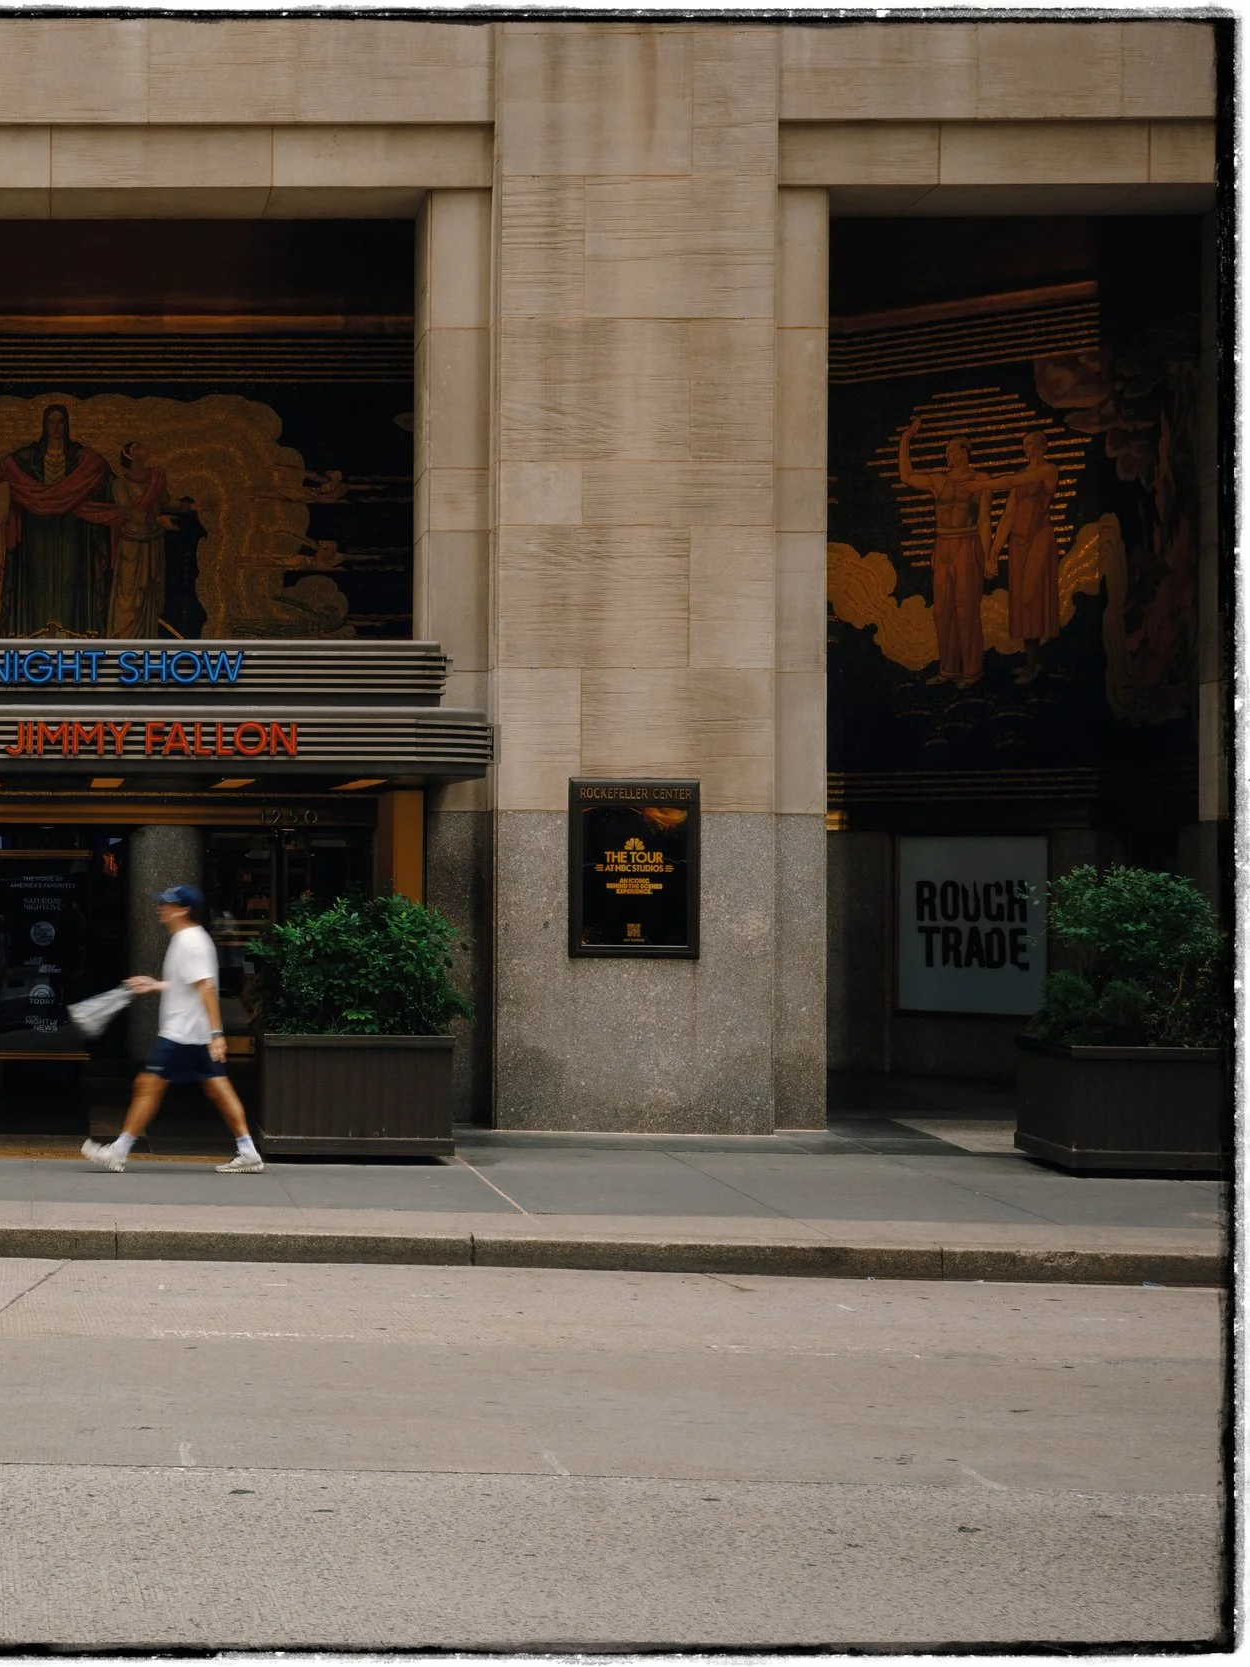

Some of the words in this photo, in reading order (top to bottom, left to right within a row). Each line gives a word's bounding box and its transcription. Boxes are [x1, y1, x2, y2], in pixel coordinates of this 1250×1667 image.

[118, 650, 243, 684] SHOW
[5, 721, 134, 756] JIMMY
[145, 721, 298, 757] FALLON
[579, 787, 648, 800] ROCKEFELLER
[652, 788, 692, 800] CENTER
[261, 809, 318, 824] 1250
[604, 851, 628, 863] THE
[629, 851, 664, 864] TOUR
[604, 864, 614, 872] AT
[614, 864, 631, 872] NBC
[632, 864, 664, 872] STUDIOS
[915, 880, 1028, 923] ROUGH
[917, 926, 1030, 971] TRADE
[25, 1017, 59, 1025] NIGHTLY
